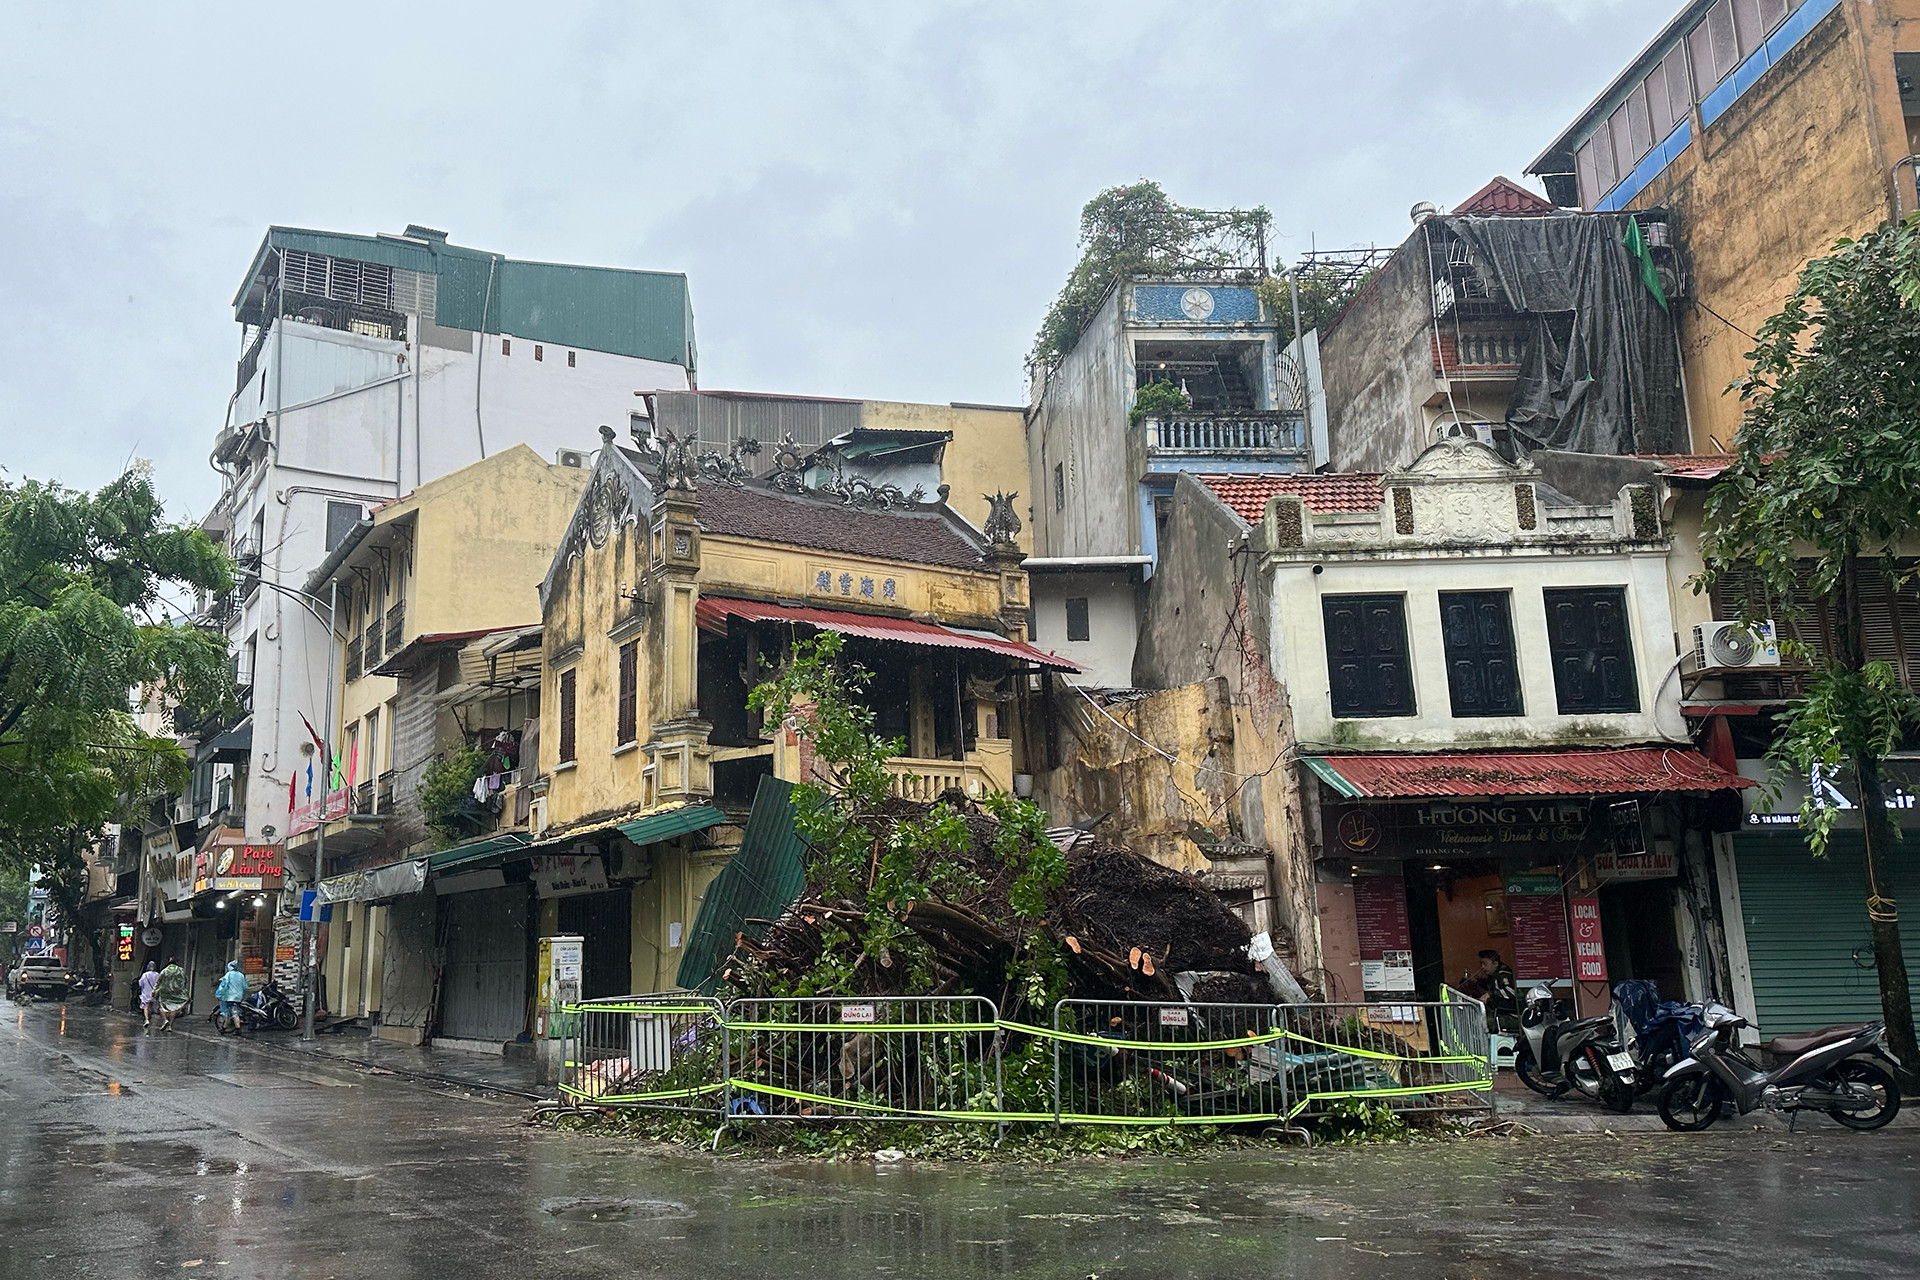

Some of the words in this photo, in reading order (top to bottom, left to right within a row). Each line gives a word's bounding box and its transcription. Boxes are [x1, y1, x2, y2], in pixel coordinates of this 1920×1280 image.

[1436, 828, 1495, 844] Vietnamese
[1498, 826, 1534, 843] Drink
[1536, 826, 1549, 842] &
[243, 846, 274, 859] Pate
[1573, 905, 1597, 919] LOCAL
[1579, 922, 1595, 938] &
[1576, 942, 1602, 956] VEGAN
[1581, 962, 1602, 976] FOOD
